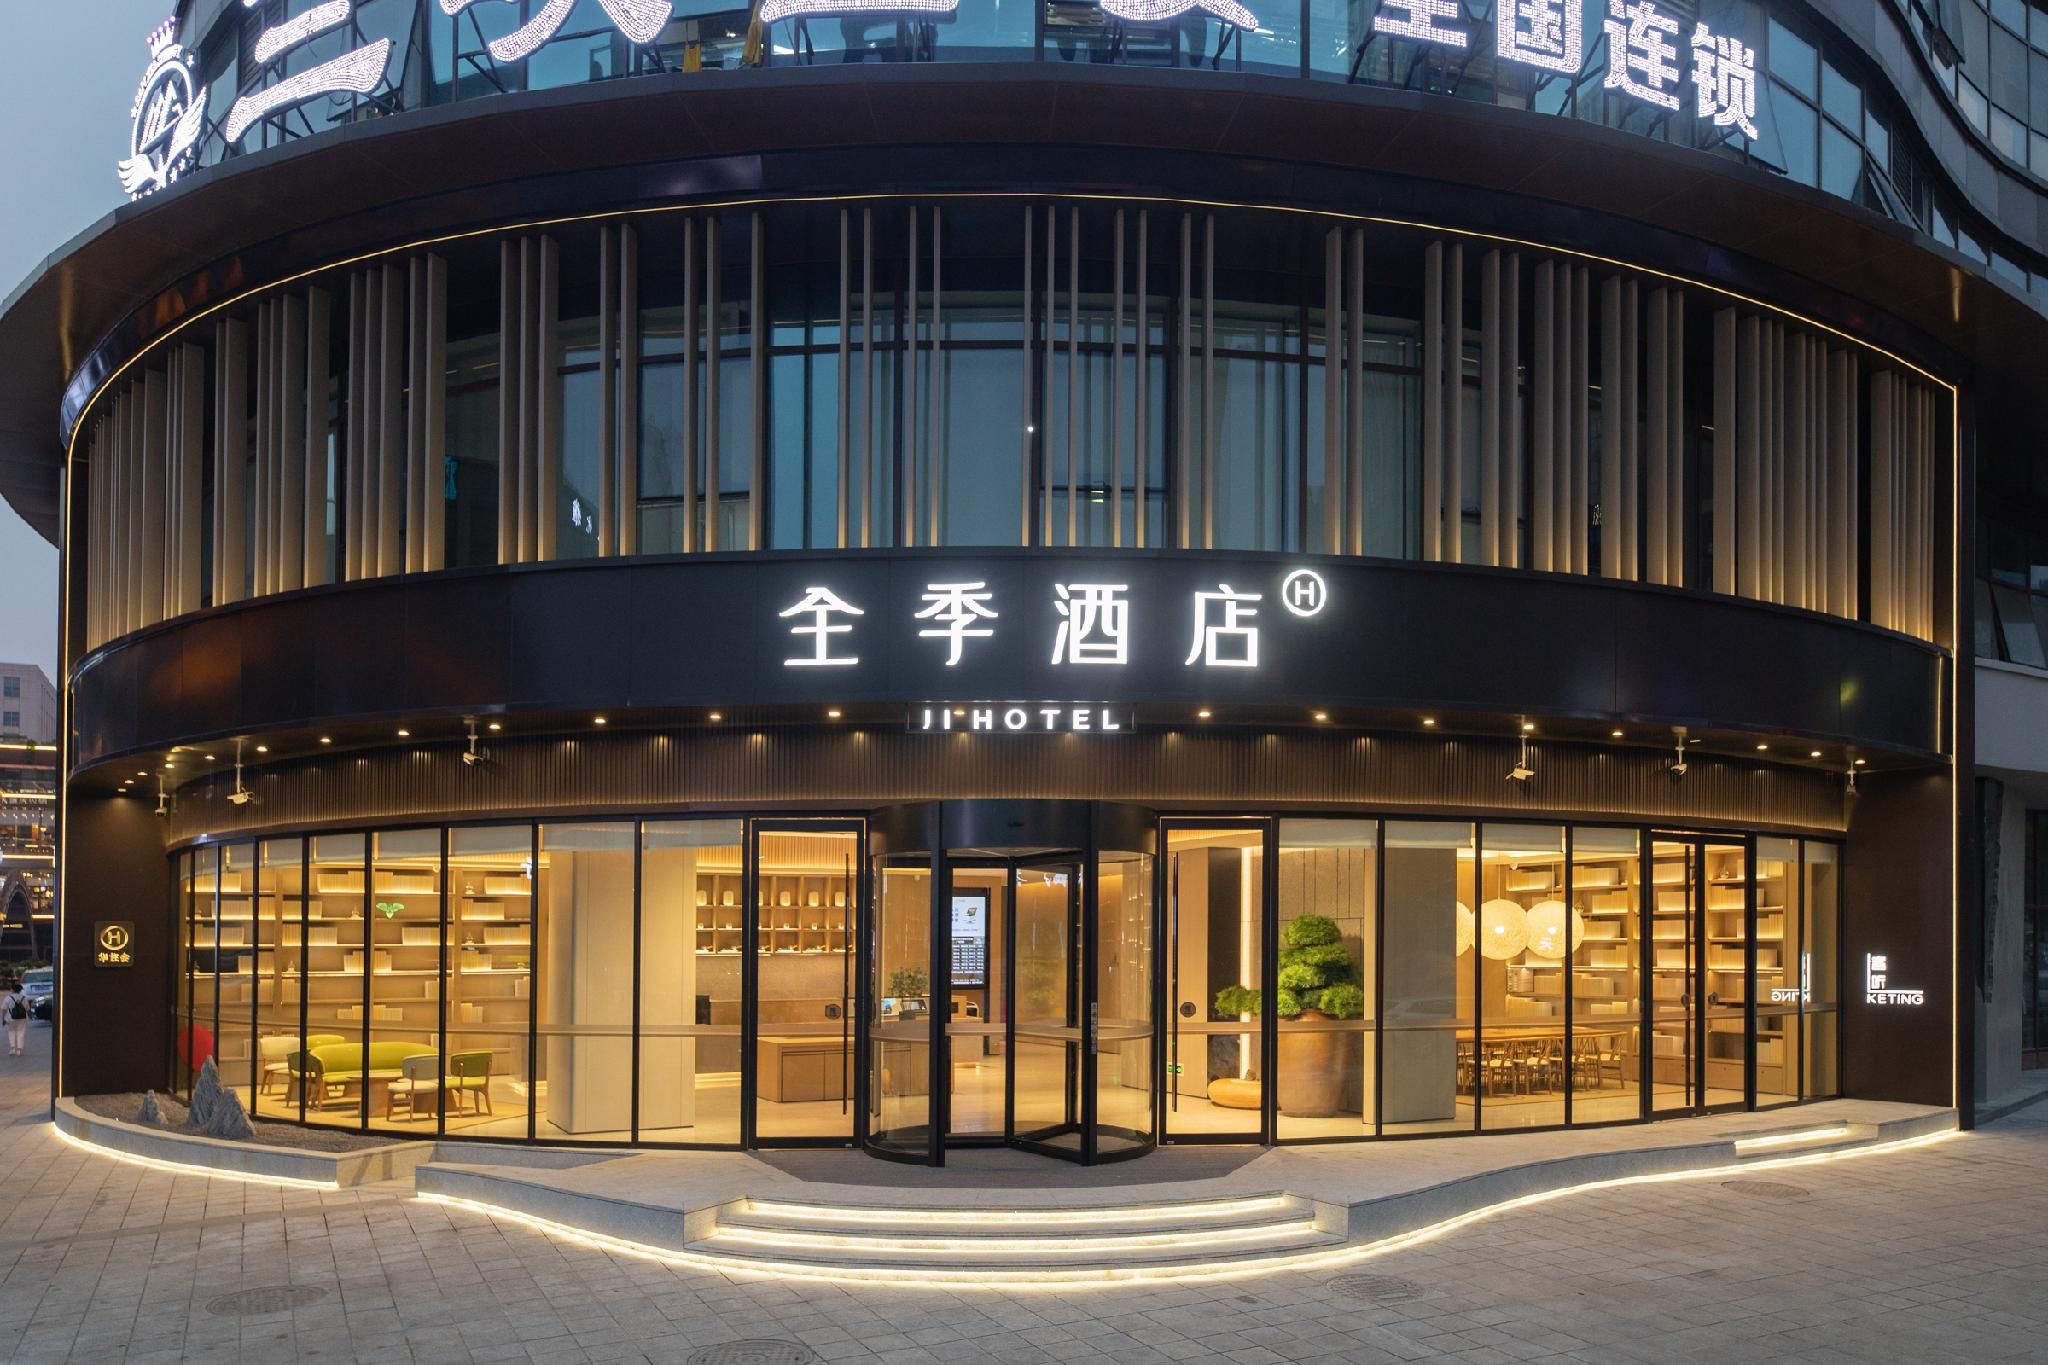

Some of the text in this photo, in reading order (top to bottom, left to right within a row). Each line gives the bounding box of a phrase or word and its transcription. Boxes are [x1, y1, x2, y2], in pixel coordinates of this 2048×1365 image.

[779, 581, 1262, 667] 全季酒店
[922, 708, 1120, 730] JI HOTEL
[1866, 993, 1924, 1005] KETING
